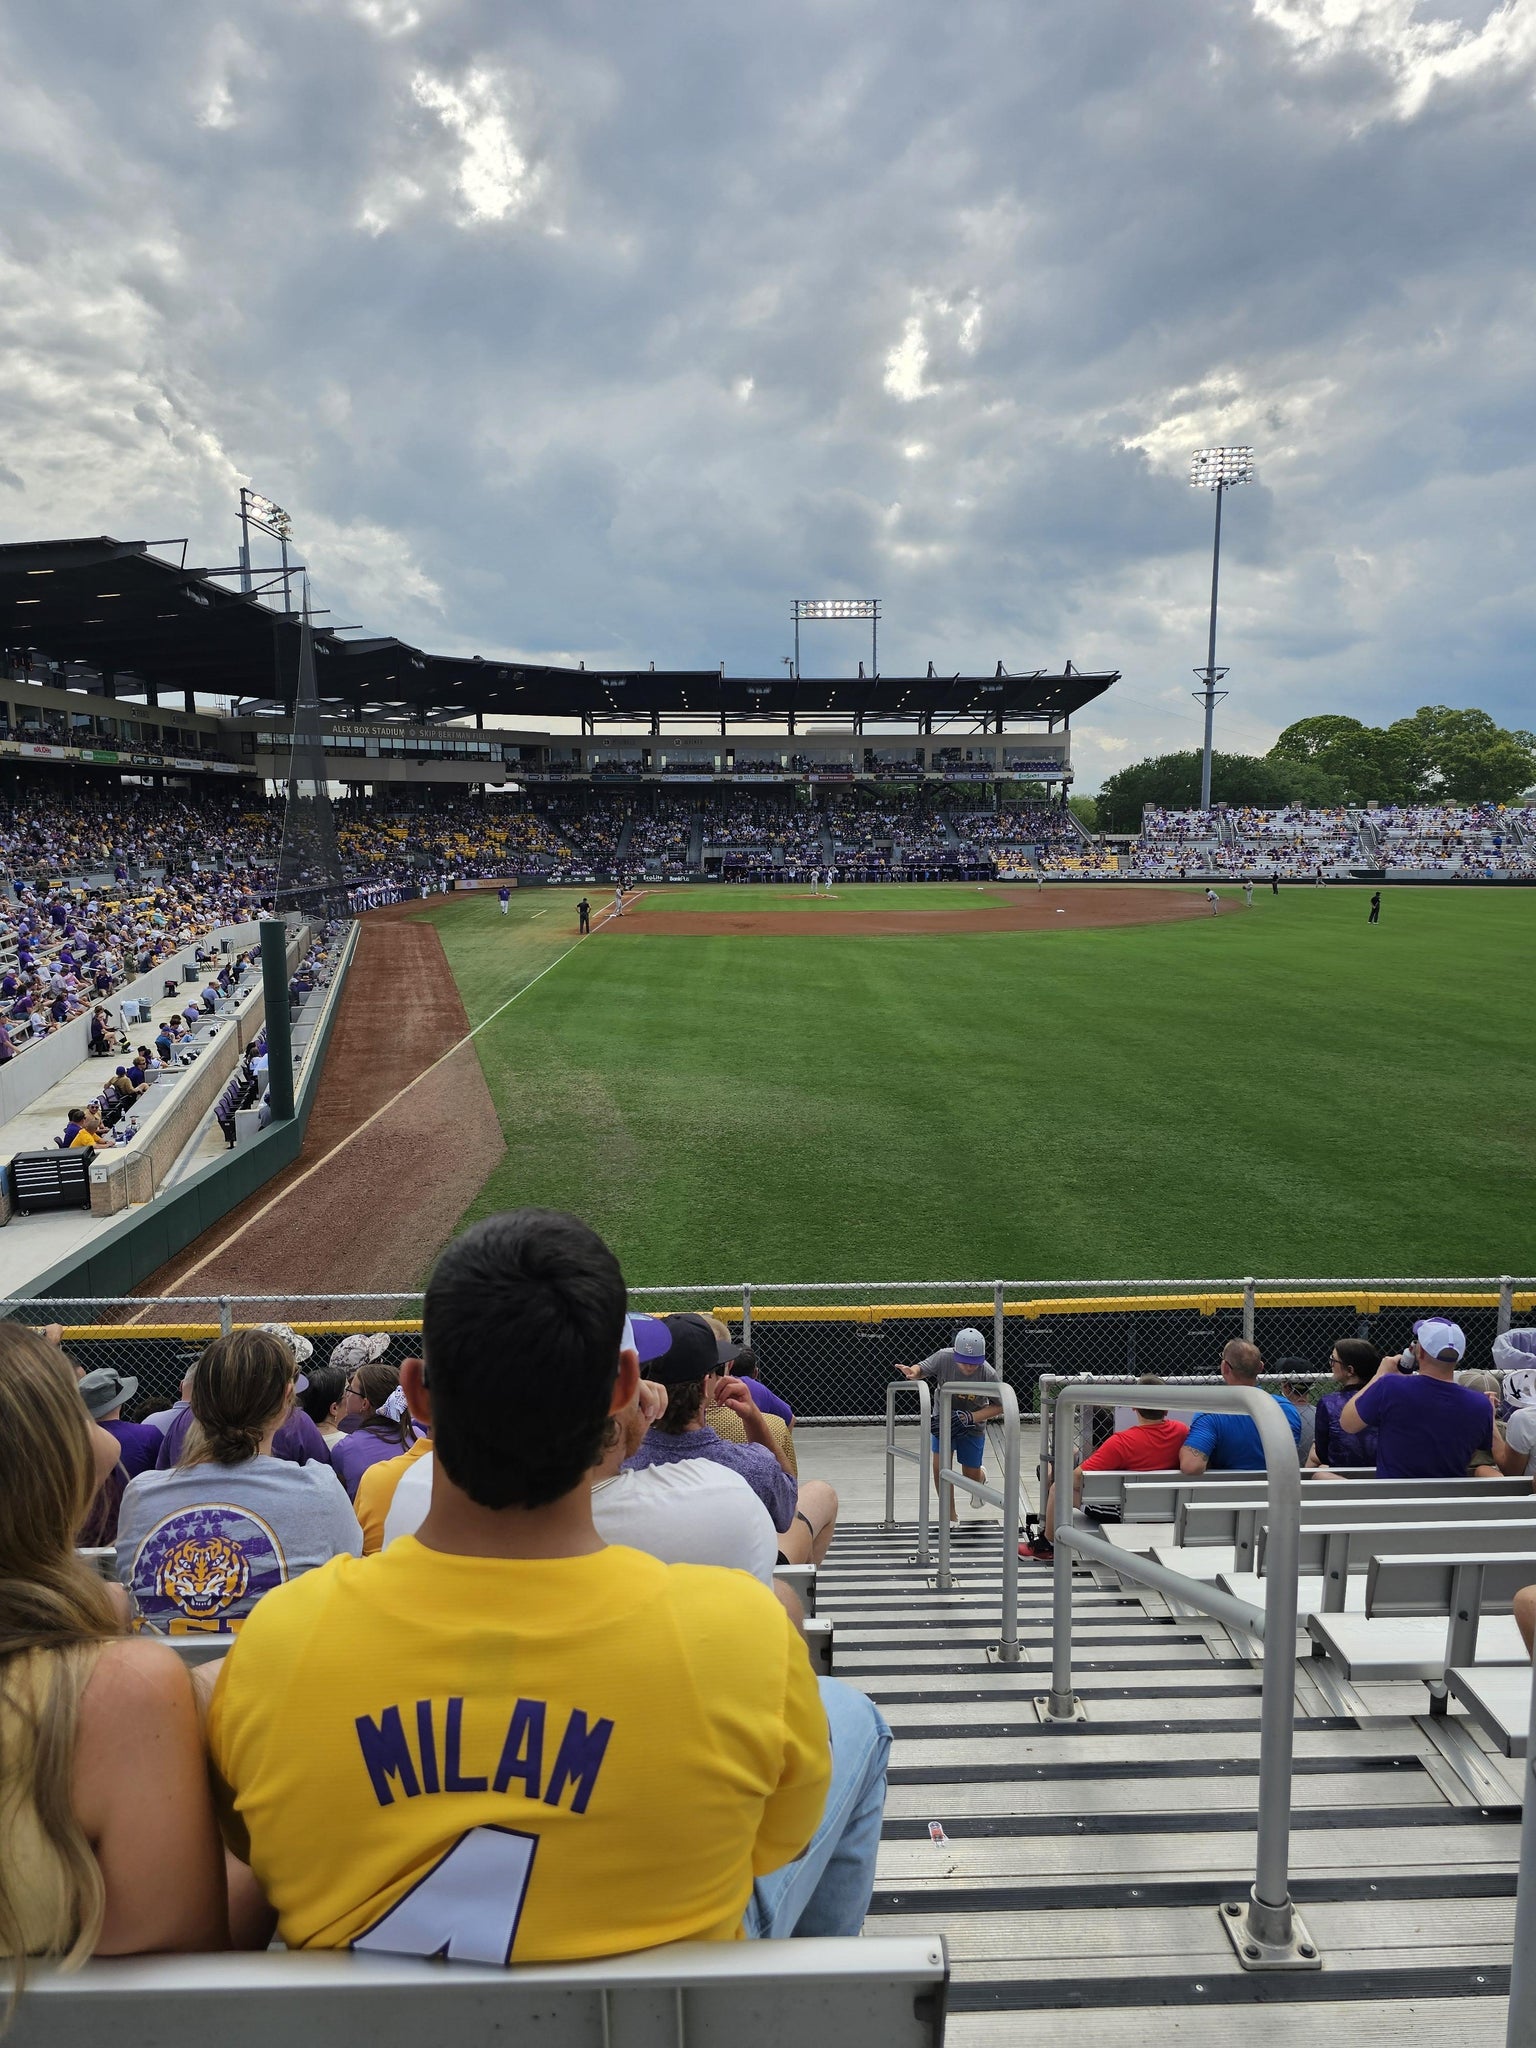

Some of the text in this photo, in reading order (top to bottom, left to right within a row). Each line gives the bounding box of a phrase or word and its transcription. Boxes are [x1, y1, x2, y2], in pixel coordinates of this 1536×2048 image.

[332, 725, 352, 733] ALEX
[354, 726, 370, 734] BOX
[372, 727, 405, 736] STADIUM
[419, 729, 436, 737] SKIP
[438, 730, 470, 739] BERTMAN
[355, 1697, 615, 1814] MILAM
